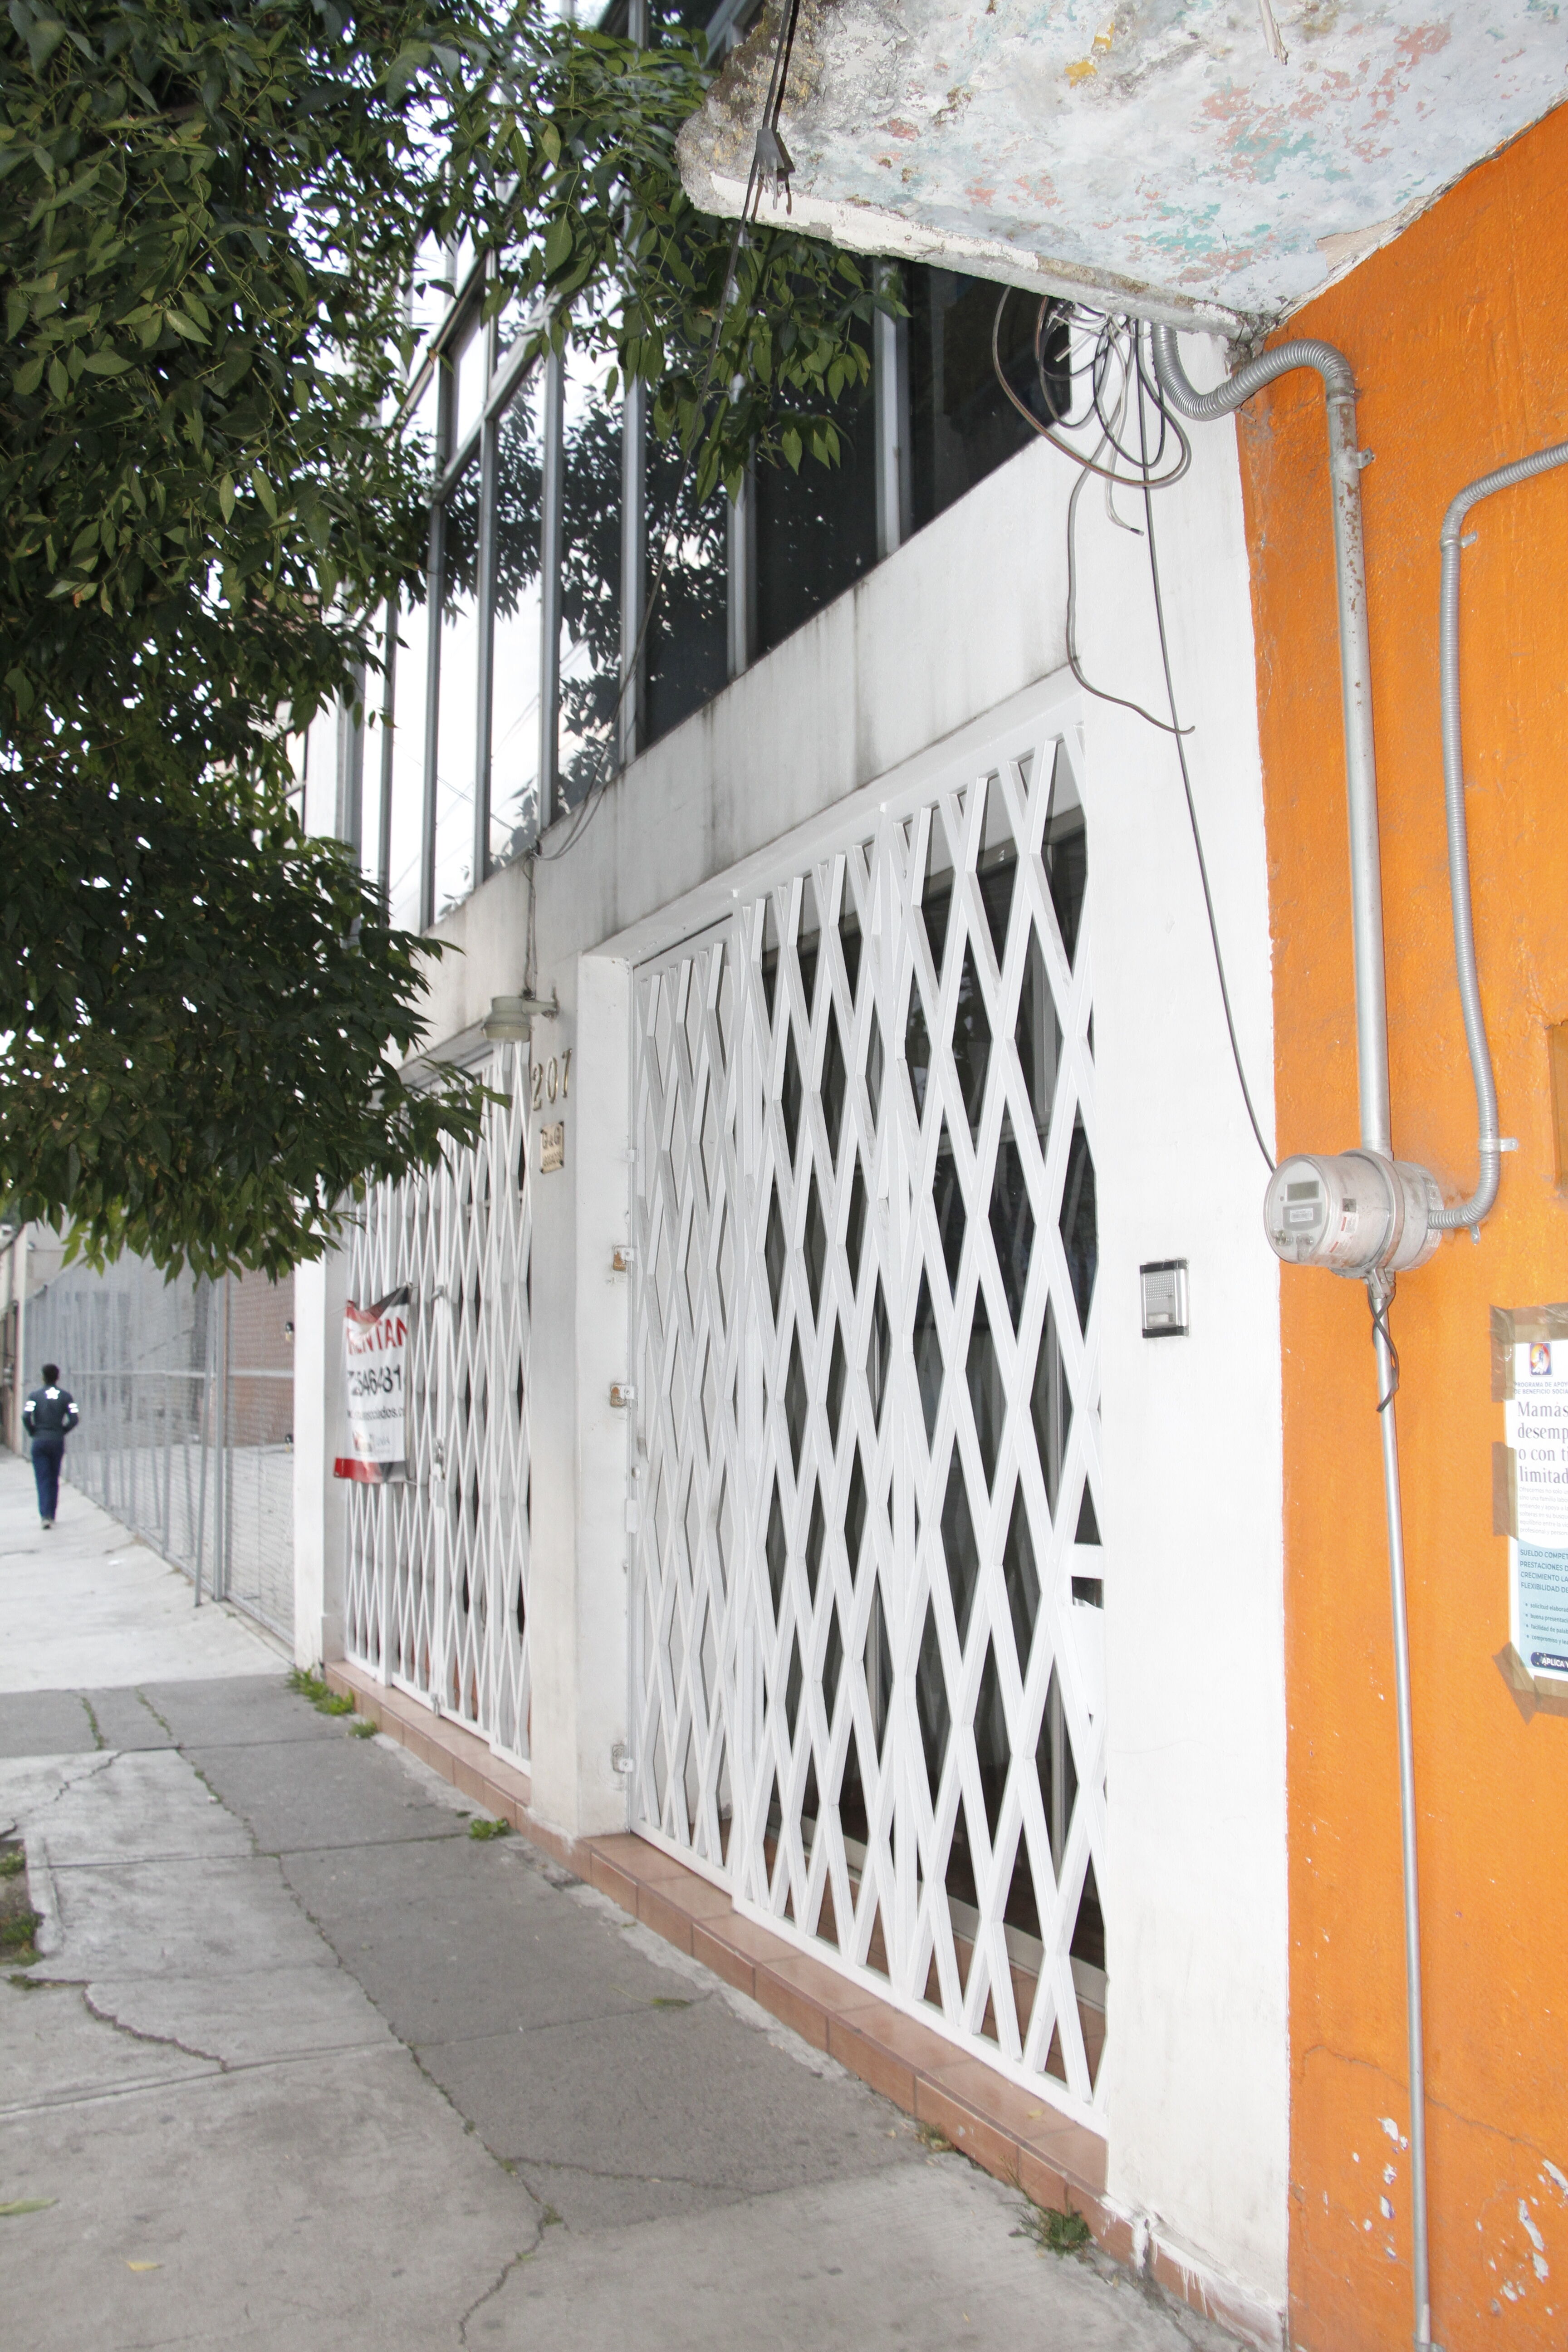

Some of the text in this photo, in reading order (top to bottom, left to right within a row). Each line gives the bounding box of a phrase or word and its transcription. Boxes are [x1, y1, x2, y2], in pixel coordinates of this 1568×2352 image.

[532, 1049, 572, 1111] 207
[1518, 1422, 1568, 1444] desemp
[1519, 1449, 1526, 1460] o
[1531, 1449, 1555, 1461] con
[1519, 1465, 1568, 1484] limitad
[1520, 1561, 1563, 1571] PRESTACIONES
[1520, 1571, 1560, 1581] CRECIMIENTO
[1521, 1582, 1560, 1592] FLEXIBILIDAD
[1532, 1634, 1558, 1643] compromiso
